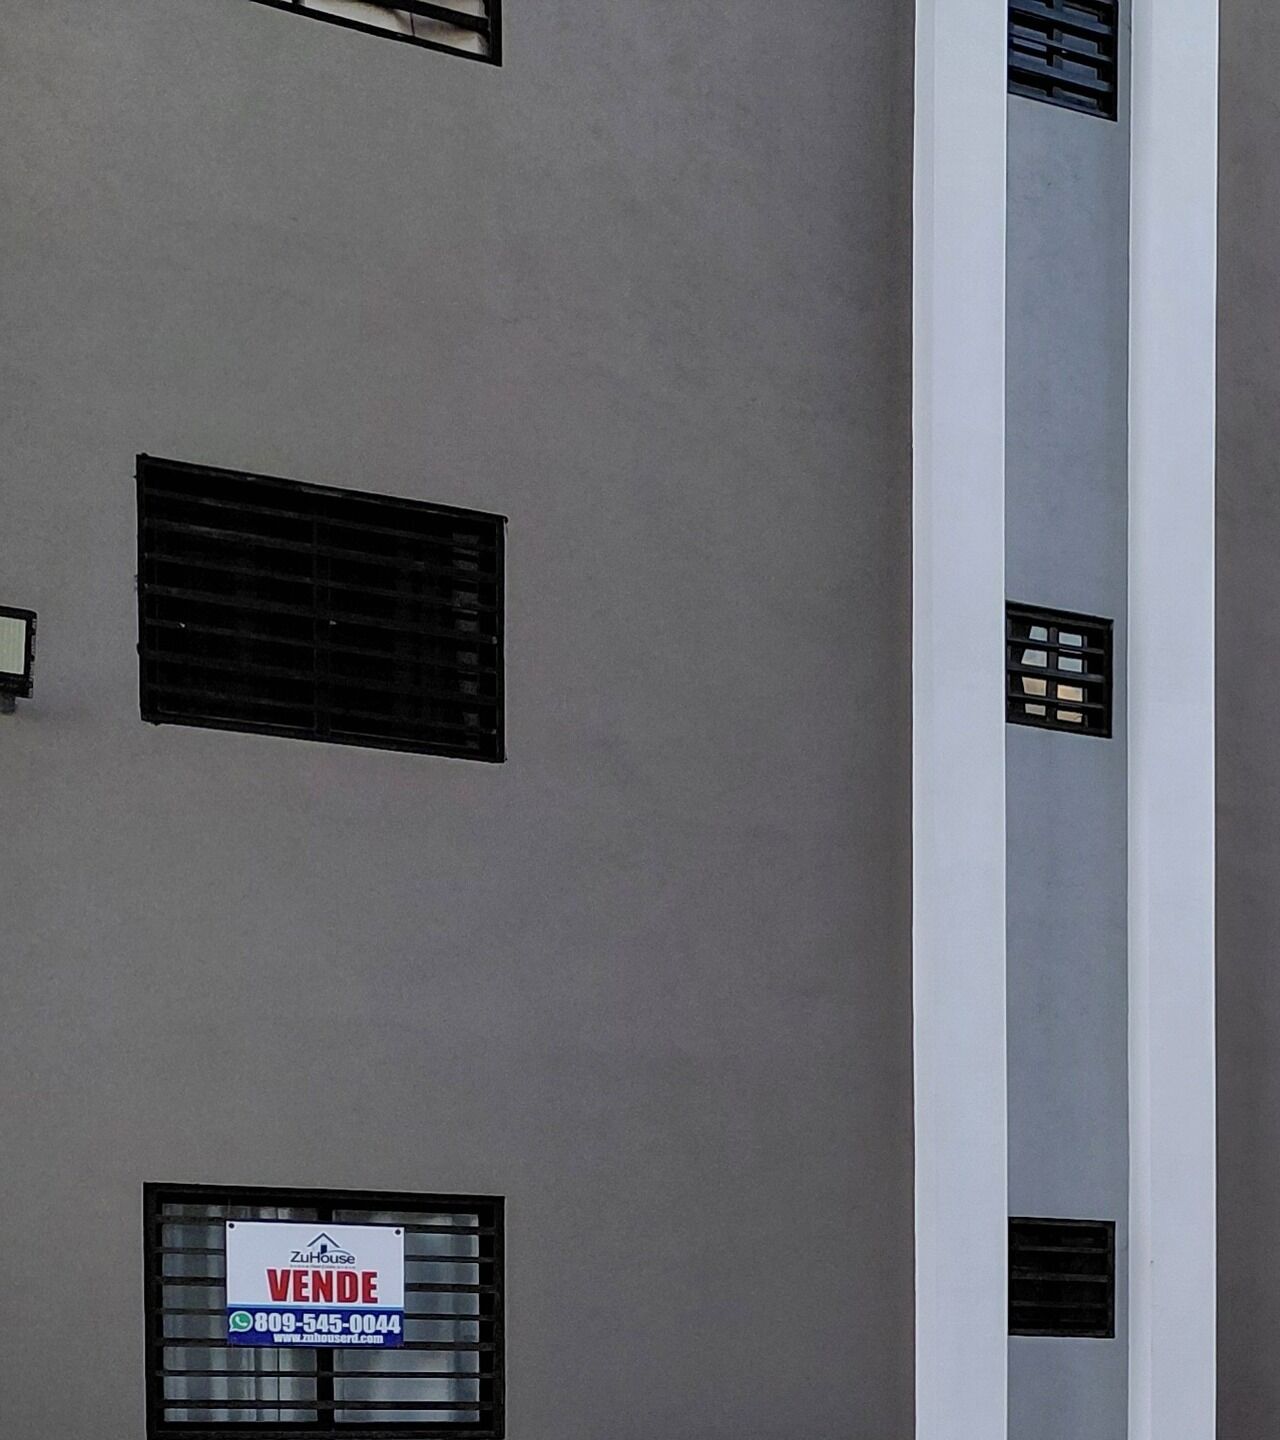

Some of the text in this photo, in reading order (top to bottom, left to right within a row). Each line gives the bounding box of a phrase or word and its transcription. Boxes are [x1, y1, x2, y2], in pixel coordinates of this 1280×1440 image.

[290, 1250, 356, 1265] ZuHouse
[266, 1268, 379, 1304] VENDE
[254, 1312, 402, 1334] 809-545-0044
